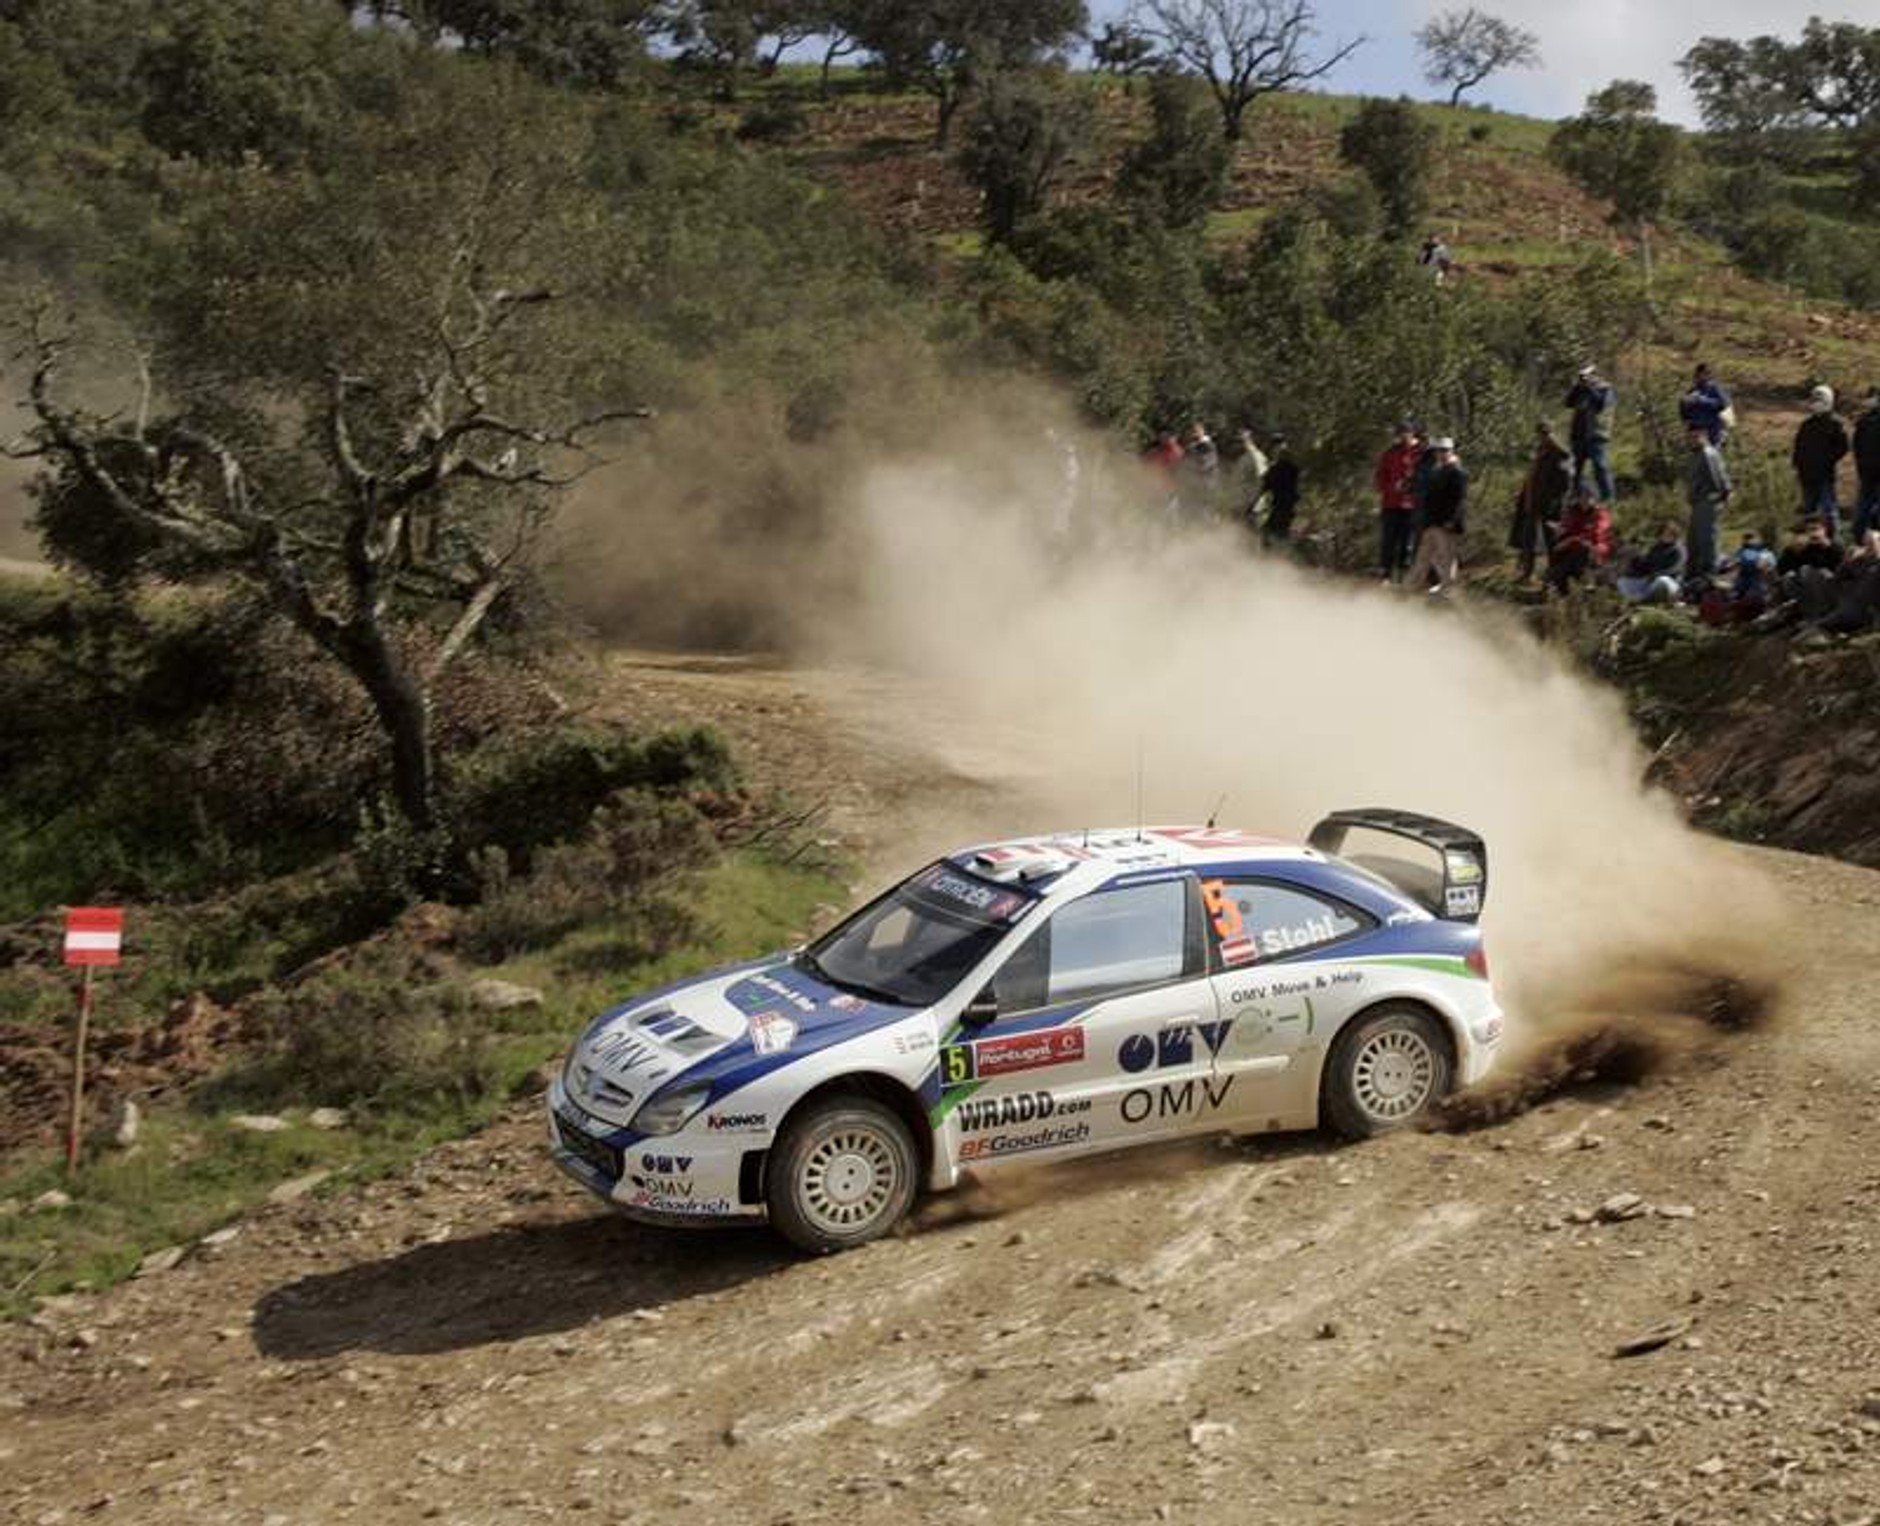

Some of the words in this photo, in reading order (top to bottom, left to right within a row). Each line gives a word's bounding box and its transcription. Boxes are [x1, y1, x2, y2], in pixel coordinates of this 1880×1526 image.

[1261, 915, 1335, 954] Stohl
[949, 1048, 967, 1081] 5
[979, 1042, 1053, 1066] Portugal
[1120, 1073, 1234, 1123] OMV
[959, 1121, 1091, 1159] BFGoodrich
